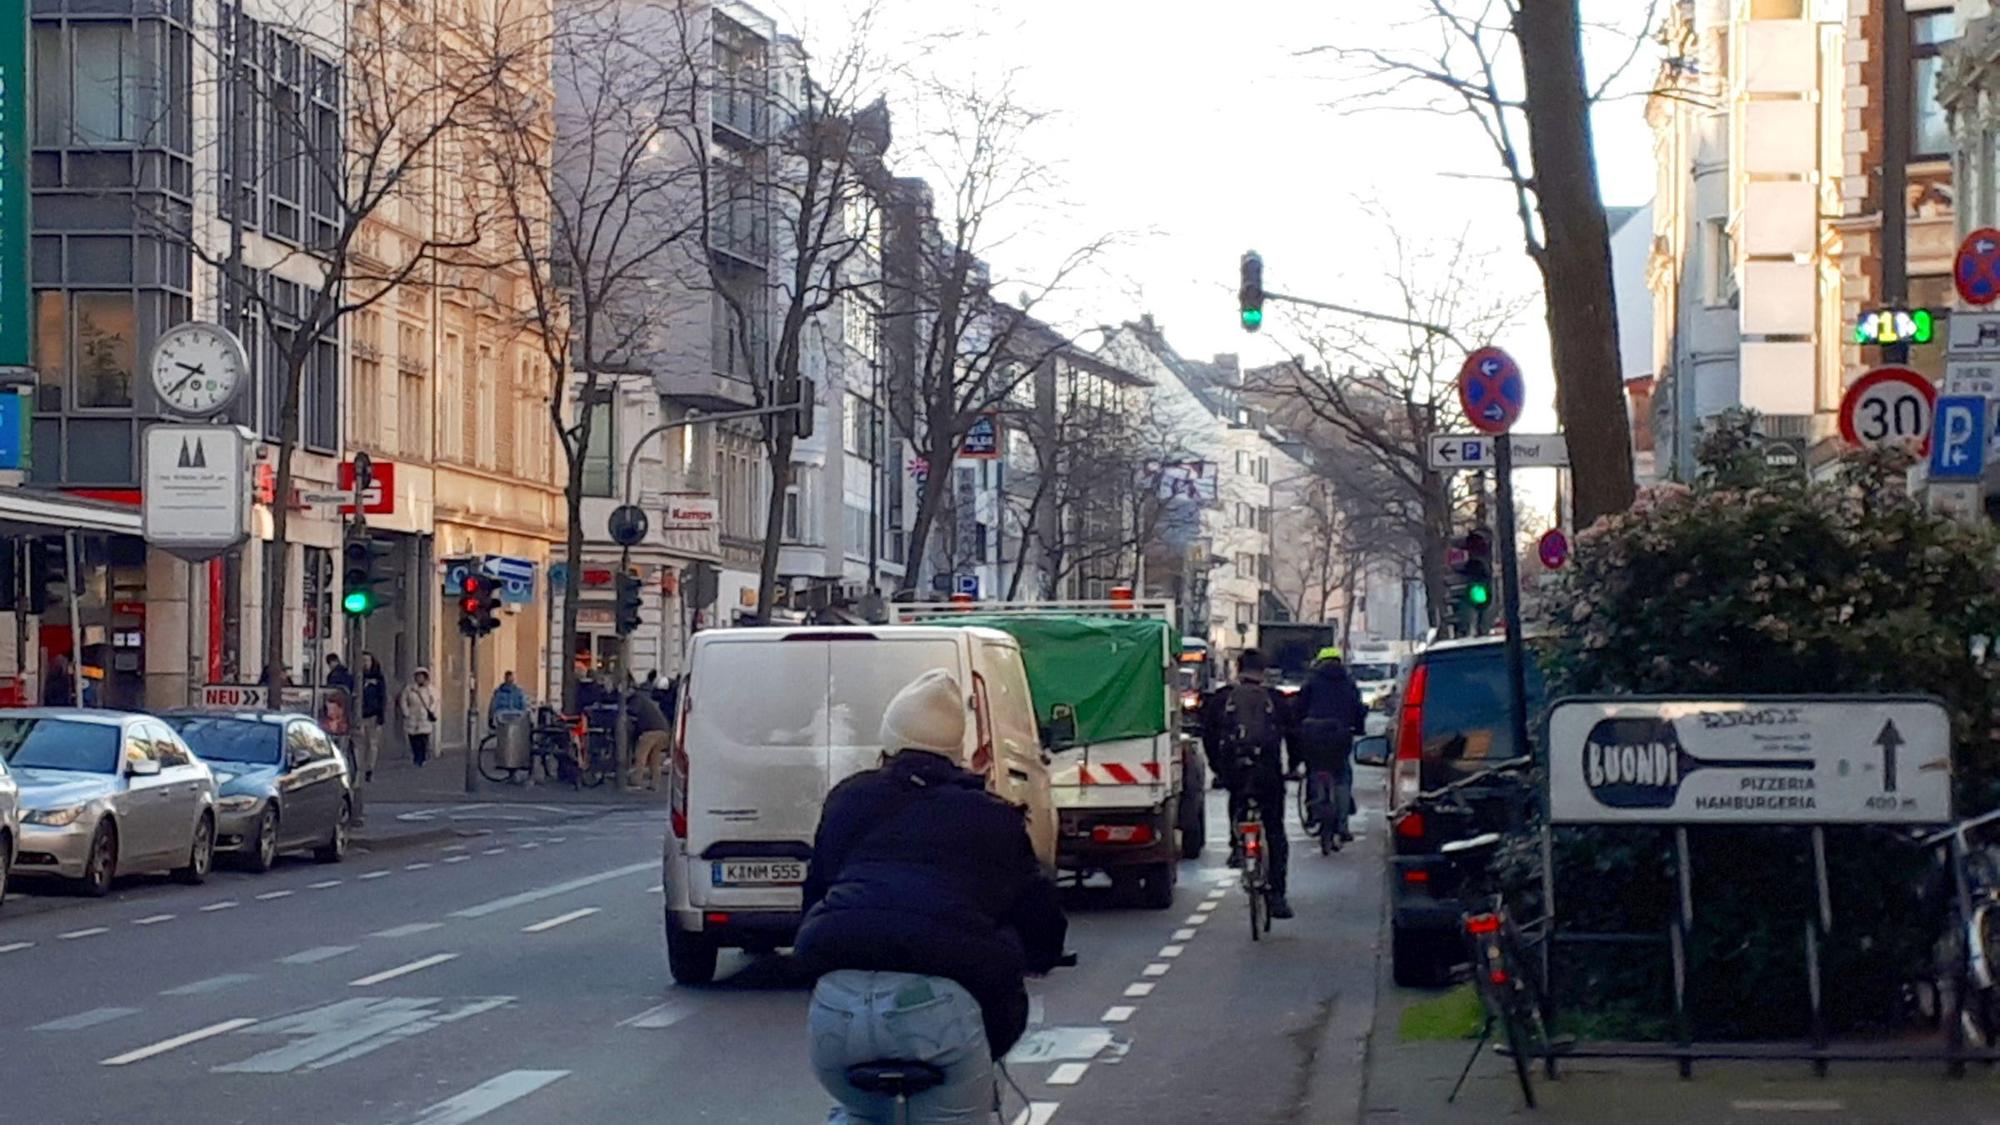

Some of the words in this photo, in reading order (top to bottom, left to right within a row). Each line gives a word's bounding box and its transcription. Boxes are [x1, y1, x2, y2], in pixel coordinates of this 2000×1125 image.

[1862, 395, 1921, 440] 30
[1941, 406, 1972, 467] P
[1466, 443, 1479, 458] P
[1485, 444, 1540, 458] Kfhof
[206, 689, 240, 705] NEU
[1740, 777, 1816, 791] PIZZERIA
[1695, 796, 1817, 810] HAMBURGERIA
[1864, 796, 1897, 810] 400
